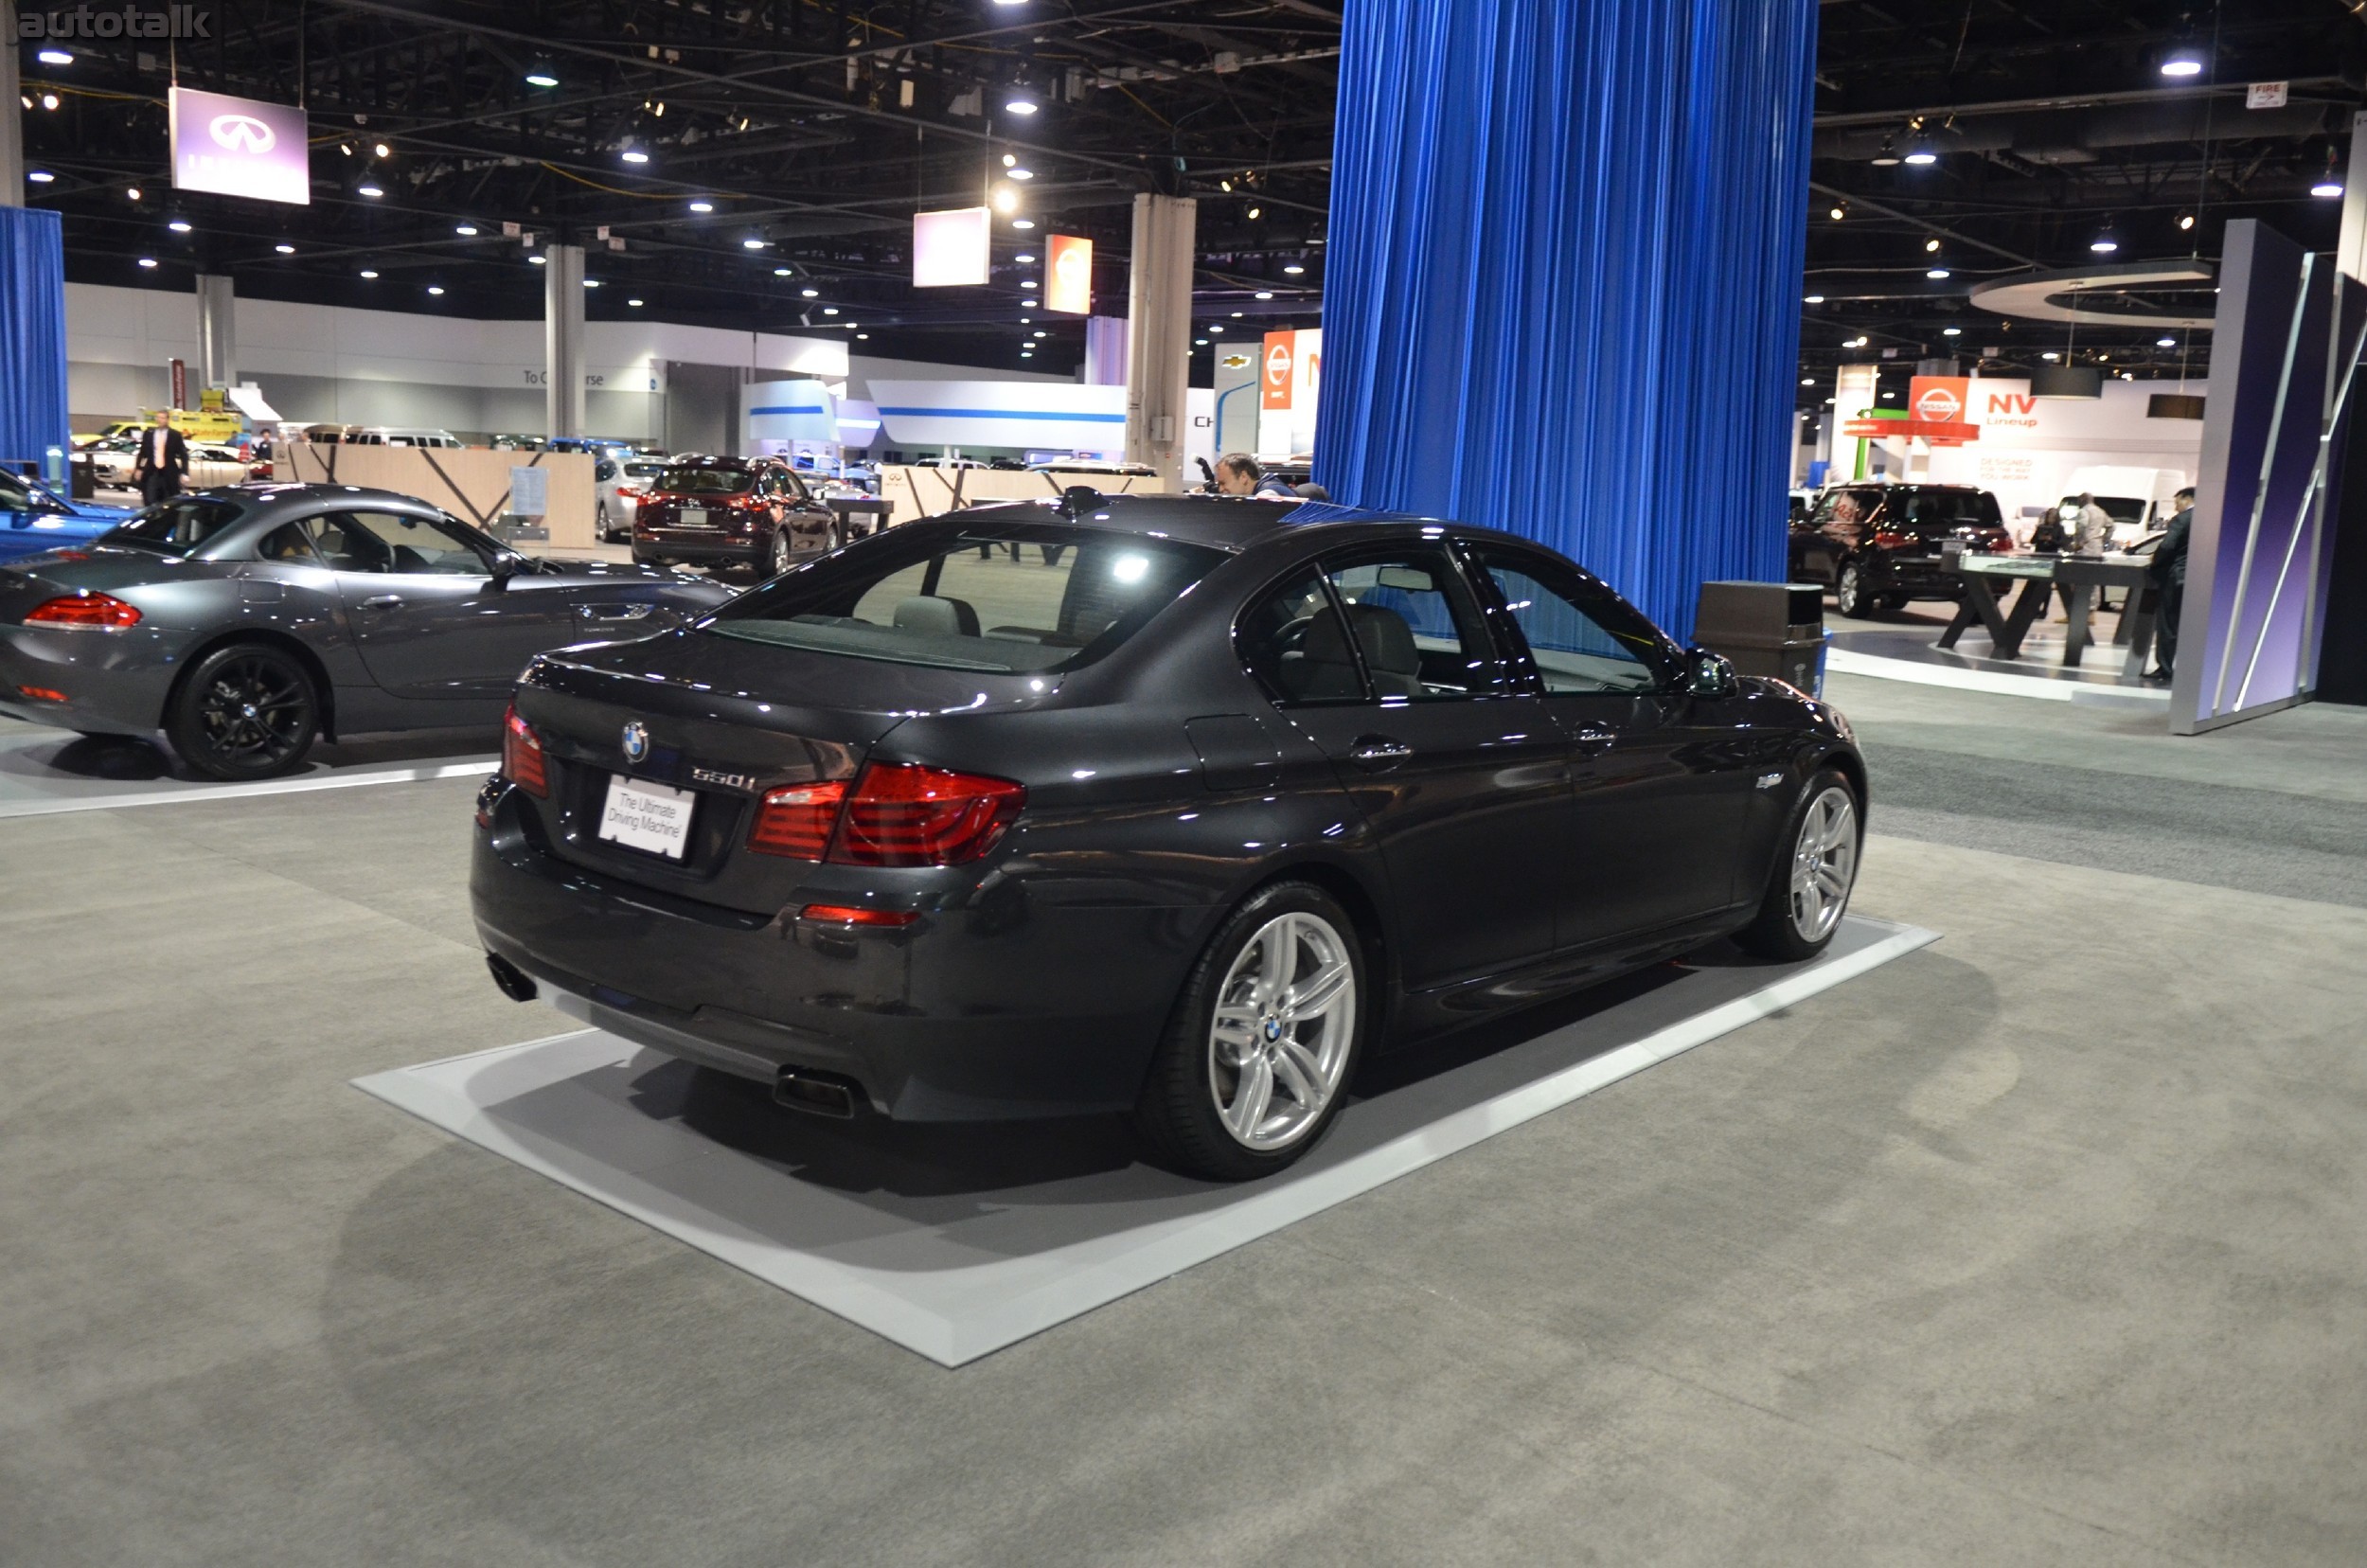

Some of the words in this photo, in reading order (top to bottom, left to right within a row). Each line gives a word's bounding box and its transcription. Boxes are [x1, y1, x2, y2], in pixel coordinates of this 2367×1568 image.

[524, 370, 538, 384] To
[1988, 393, 2038, 414] NV
[1986, 417, 2038, 428] Lineup
[620, 793, 637, 810] The
[638, 797, 676, 819] Ultimate
[608, 808, 639, 831] Driving
